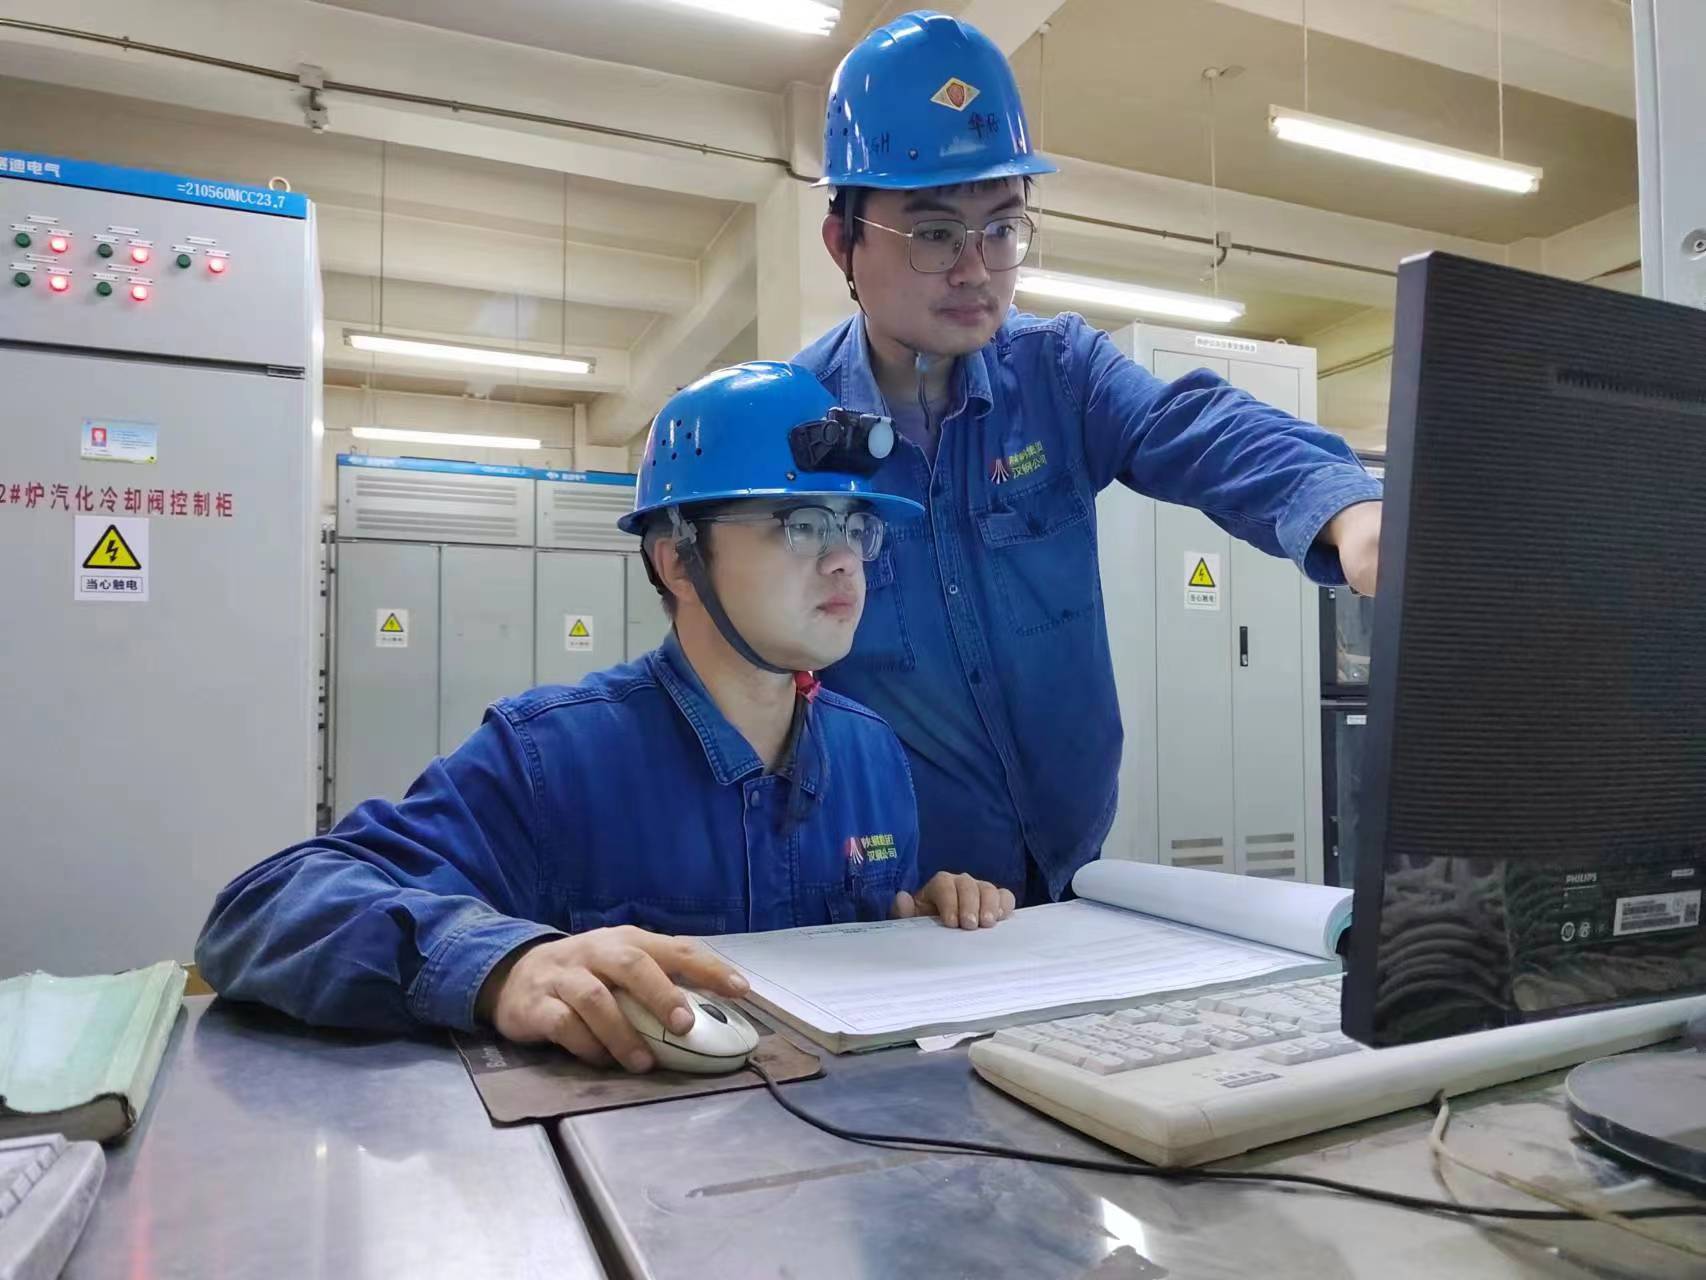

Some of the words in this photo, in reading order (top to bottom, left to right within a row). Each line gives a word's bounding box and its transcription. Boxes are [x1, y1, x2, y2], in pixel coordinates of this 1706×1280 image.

[176, 182, 286, 210] =210560MCC23.7
[0, 480, 233, 518] 2#炉汽化冷却阀控制柜
[85, 577, 139, 592] 当心触电
[1565, 872, 1598, 883] PHILIPS
